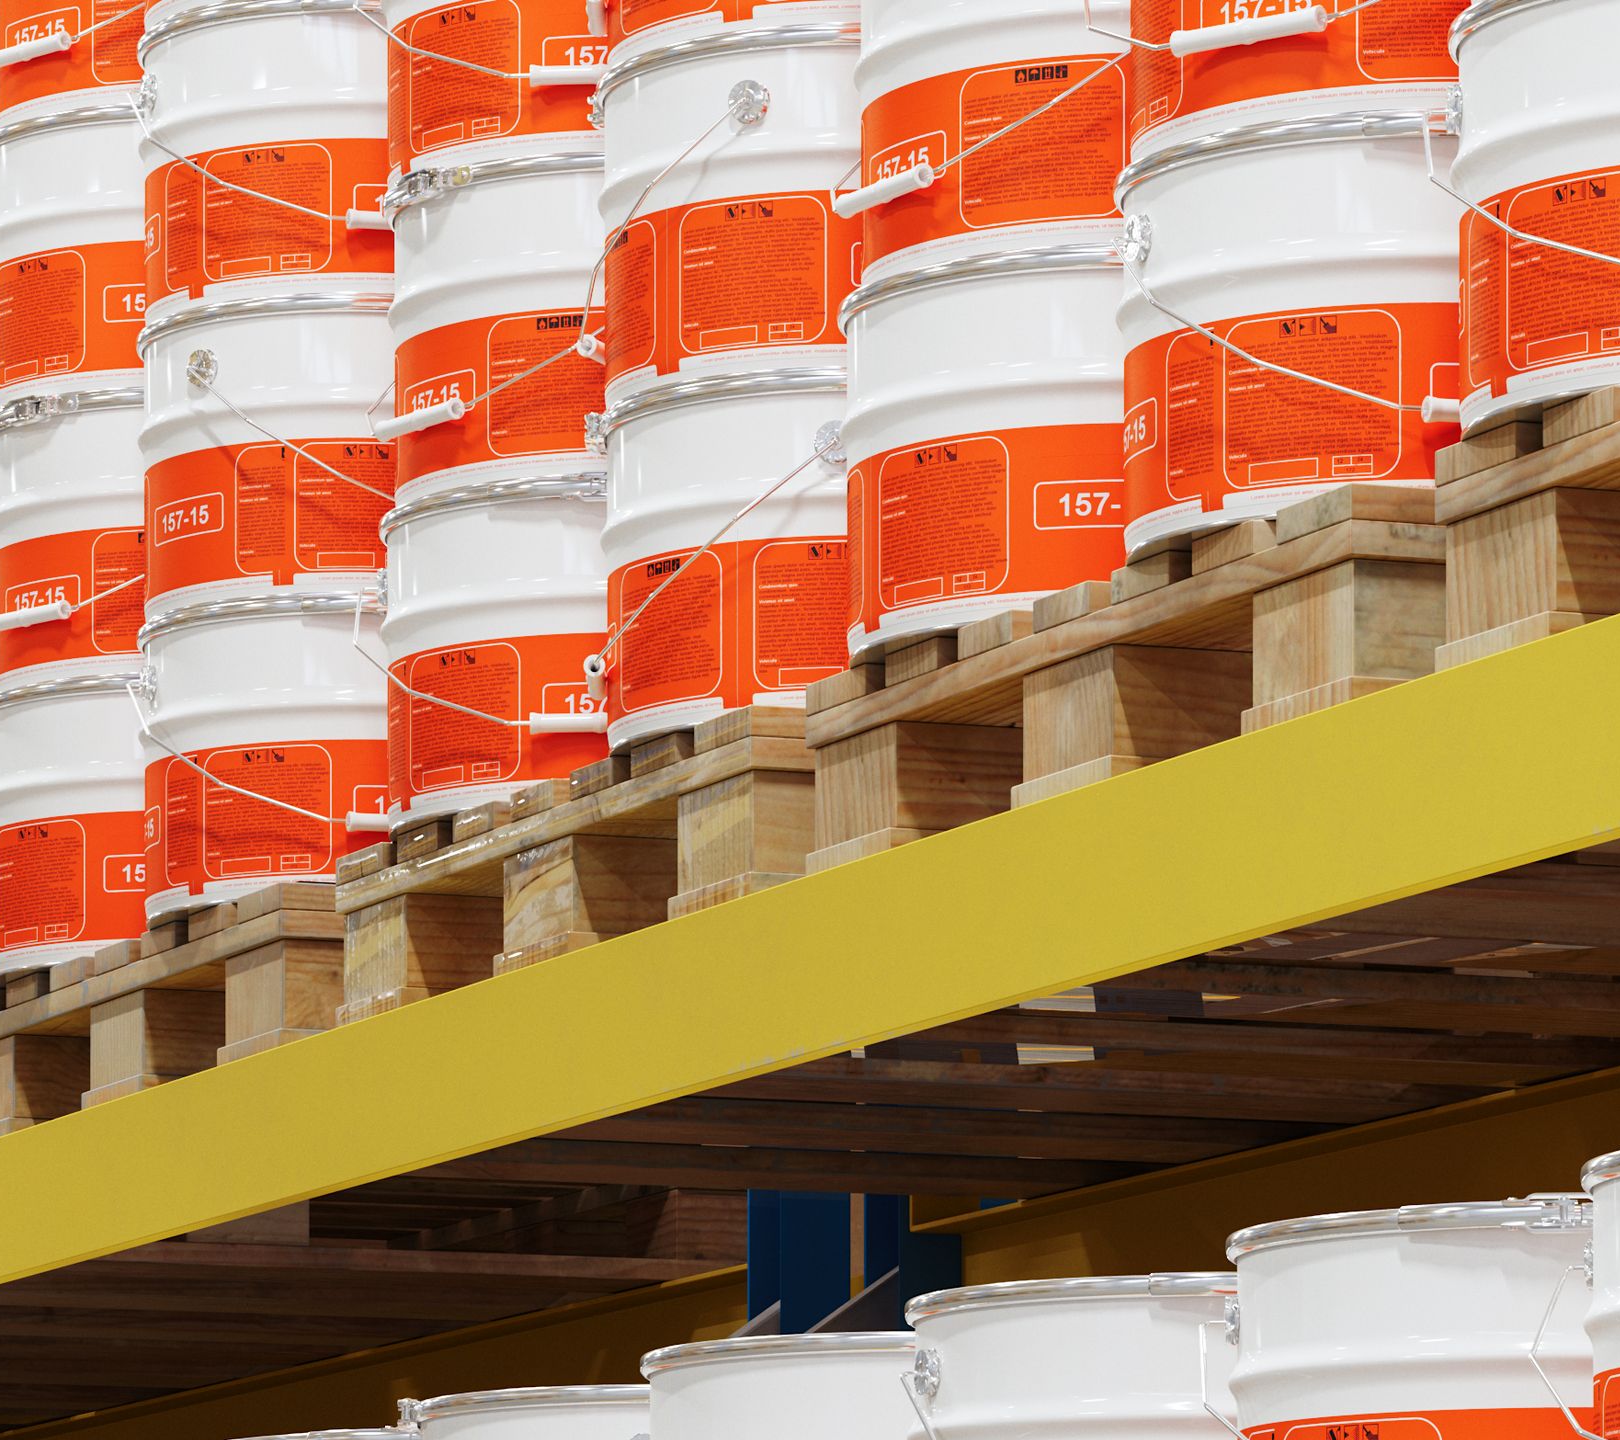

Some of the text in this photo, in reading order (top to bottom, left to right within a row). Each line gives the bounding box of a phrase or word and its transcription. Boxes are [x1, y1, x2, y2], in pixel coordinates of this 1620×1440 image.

[565, 47, 609, 66] 157
[1059, 493, 1122, 517] 157-
[163, 505, 209, 533] 157-15
